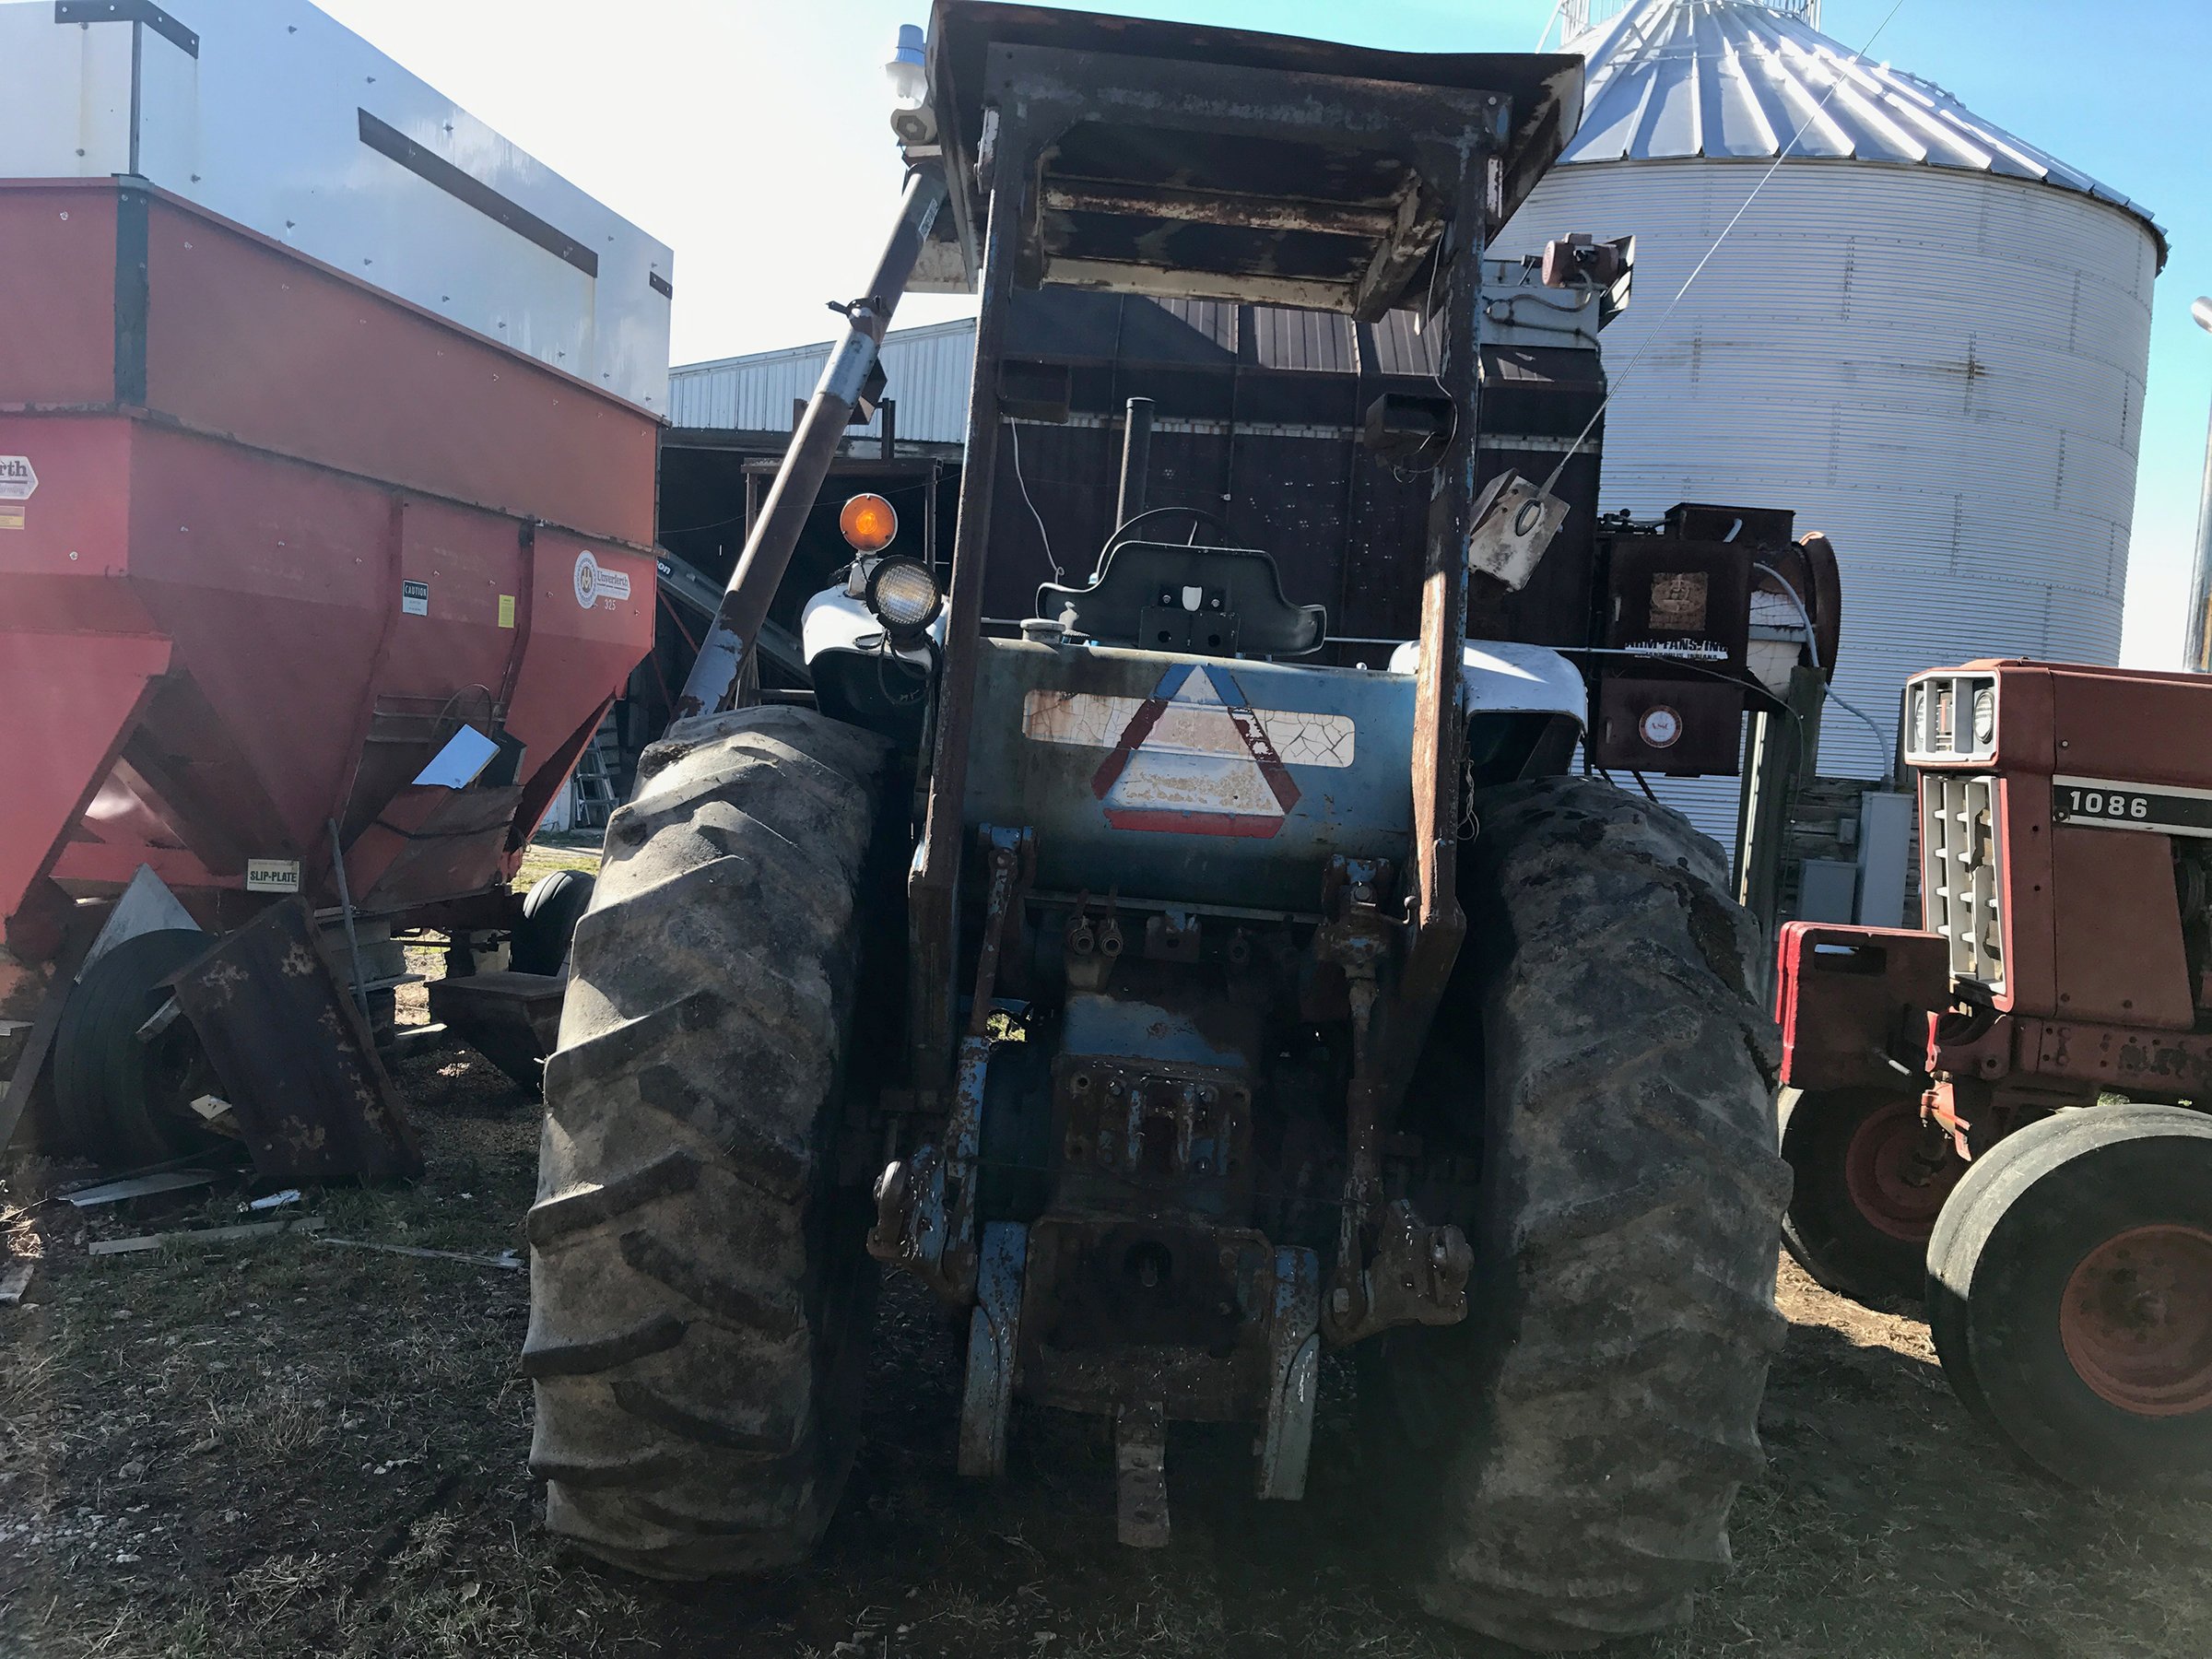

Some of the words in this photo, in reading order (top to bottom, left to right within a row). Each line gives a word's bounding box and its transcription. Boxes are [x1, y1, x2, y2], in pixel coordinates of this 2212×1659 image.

[406, 584, 427, 597] CAUTION
[604, 597, 617, 611] 325
[2070, 791, 2147, 818] 1086
[250, 871, 297, 882] SLIP-PLATE
